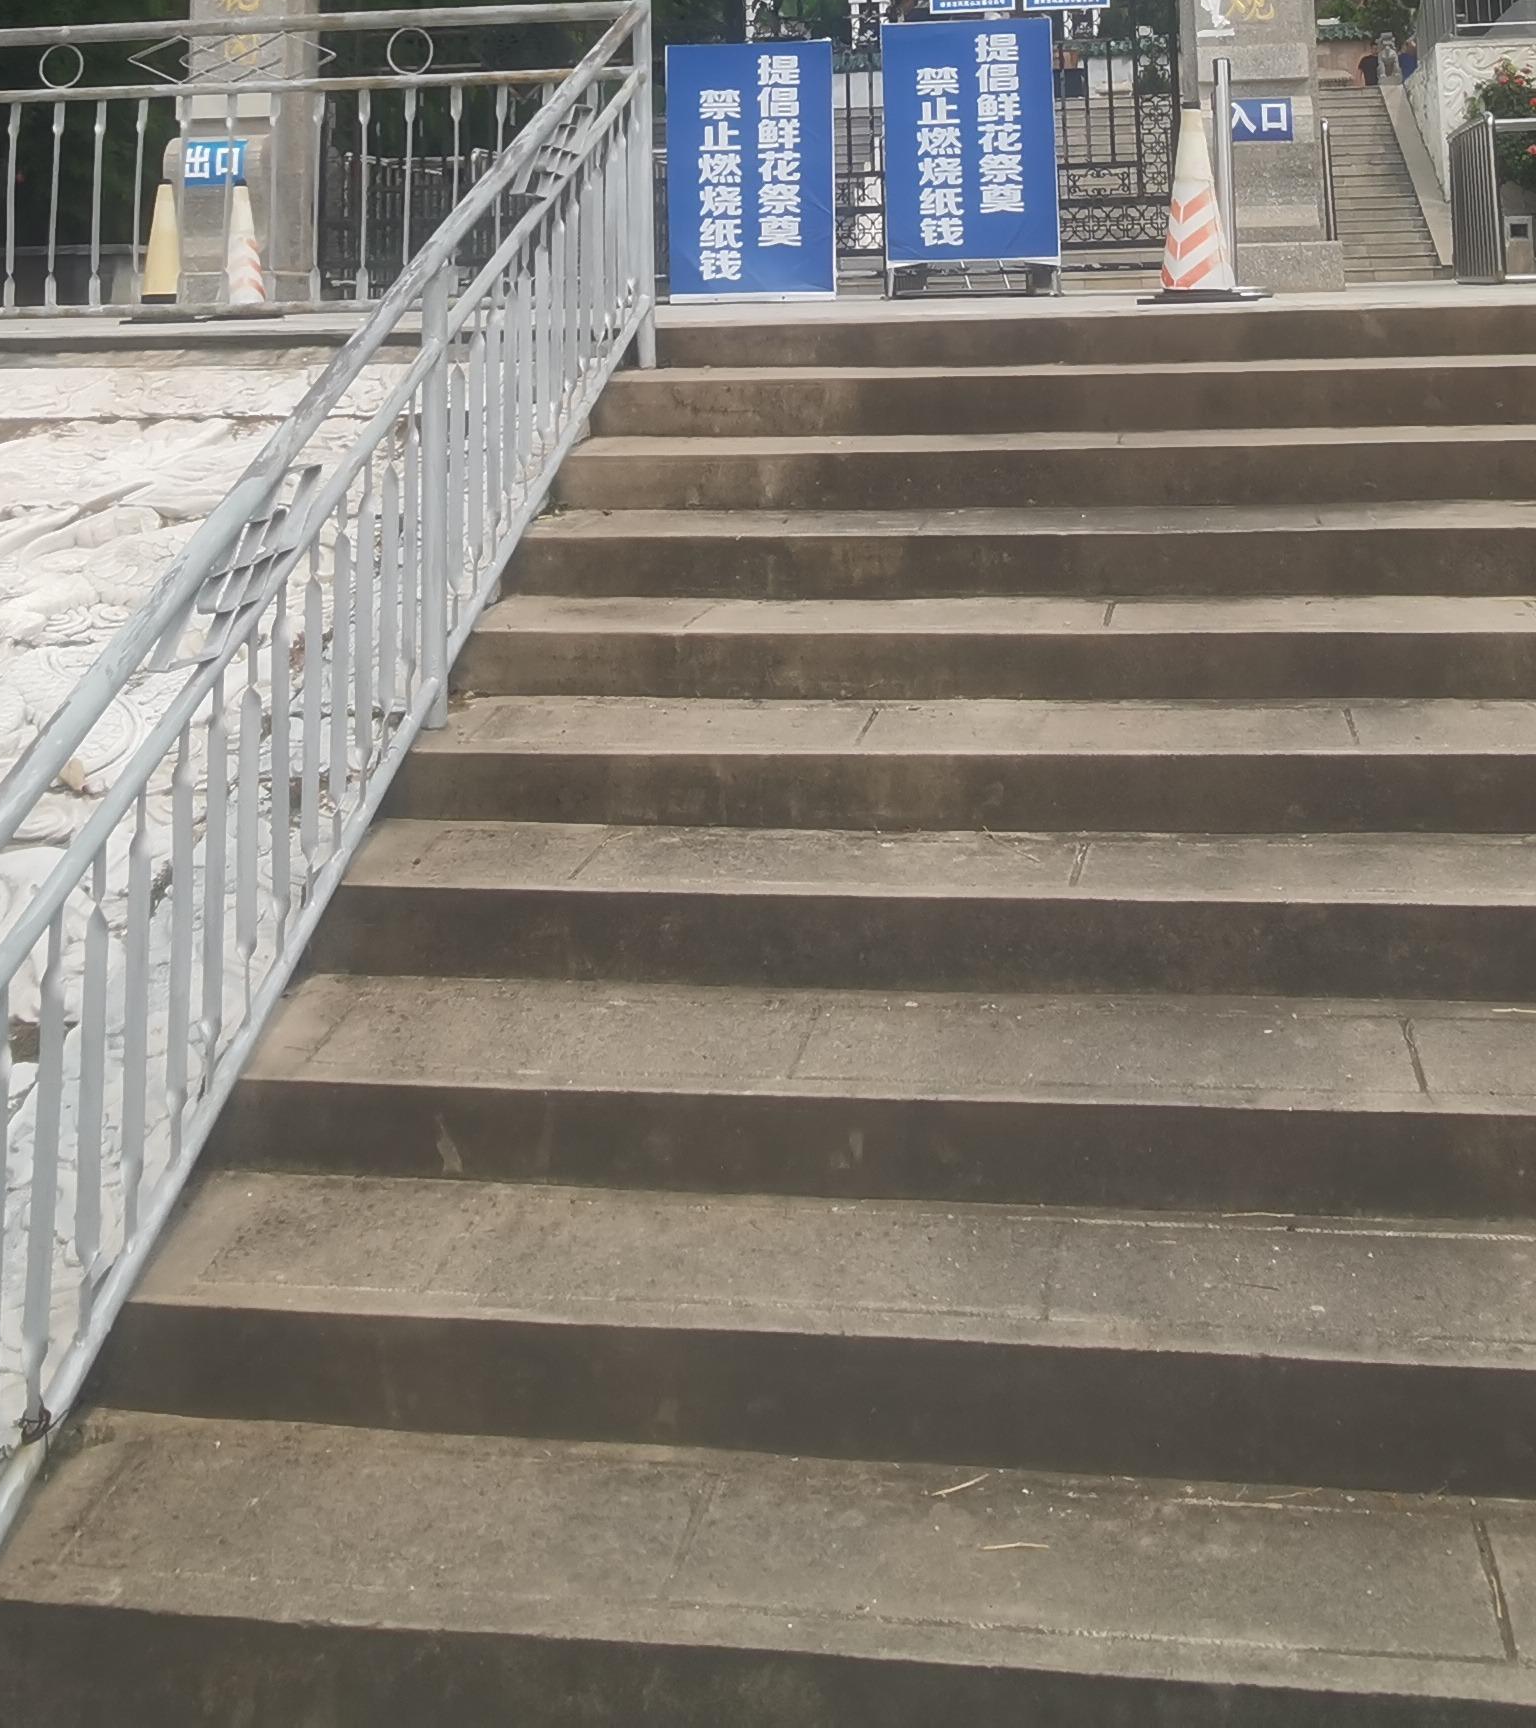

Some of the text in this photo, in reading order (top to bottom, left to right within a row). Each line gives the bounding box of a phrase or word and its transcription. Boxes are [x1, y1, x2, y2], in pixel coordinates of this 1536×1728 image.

[184, 145, 240, 178] 出口
[698, 89, 744, 281] 禁止燃烧纸钱
[757, 55, 802, 248] 提倡鲜花祭奠
[915, 66, 965, 247] 禁止燃烧纸钱
[974, 33, 1025, 214] 提倡鲜花祭奠
[1231, 102, 1288, 133] 入口
